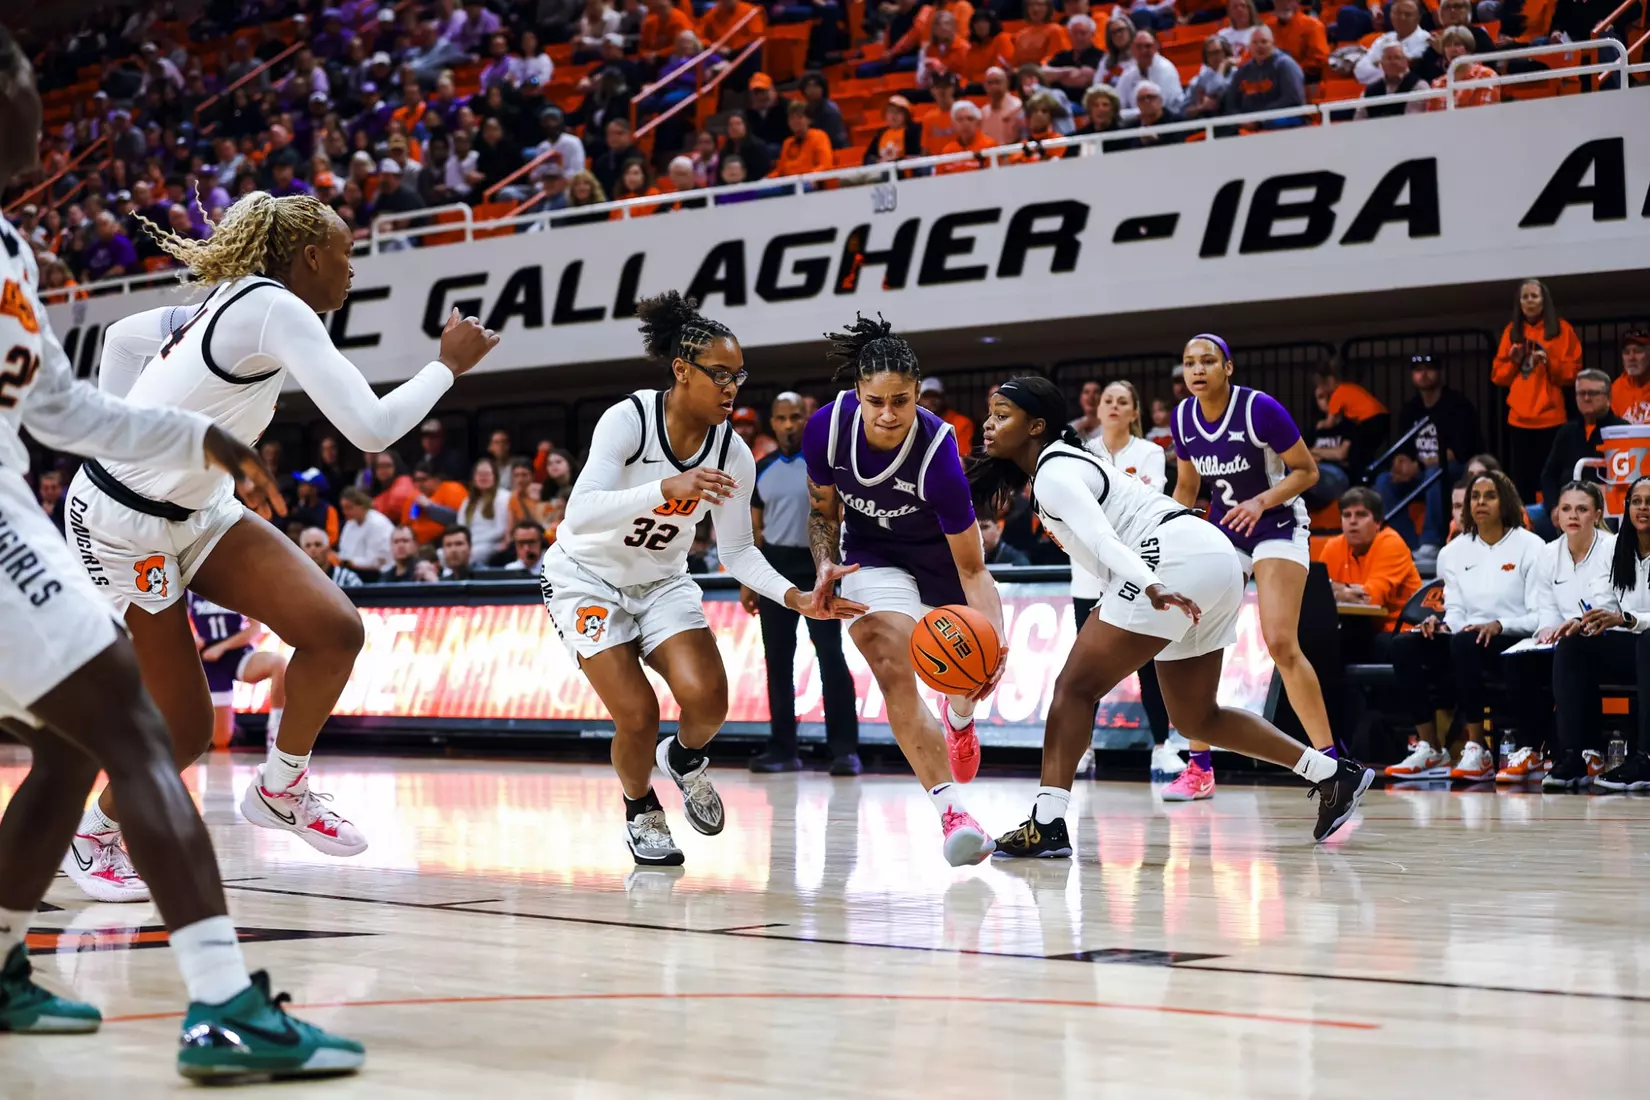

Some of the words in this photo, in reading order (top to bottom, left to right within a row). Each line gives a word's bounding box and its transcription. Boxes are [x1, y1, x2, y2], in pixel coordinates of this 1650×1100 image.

[421, 199, 1090, 338] GALLAGHER
[1518, 137, 1650, 228] A
[1190, 453, 1251, 476] Wildcats
[1612, 452, 1630, 476] G
[1215, 479, 1238, 507] 2
[623, 517, 679, 551] 32
[0, 511, 62, 609] GIRLS
[207, 615, 228, 640] 11
[933, 615, 973, 660] ELITE
